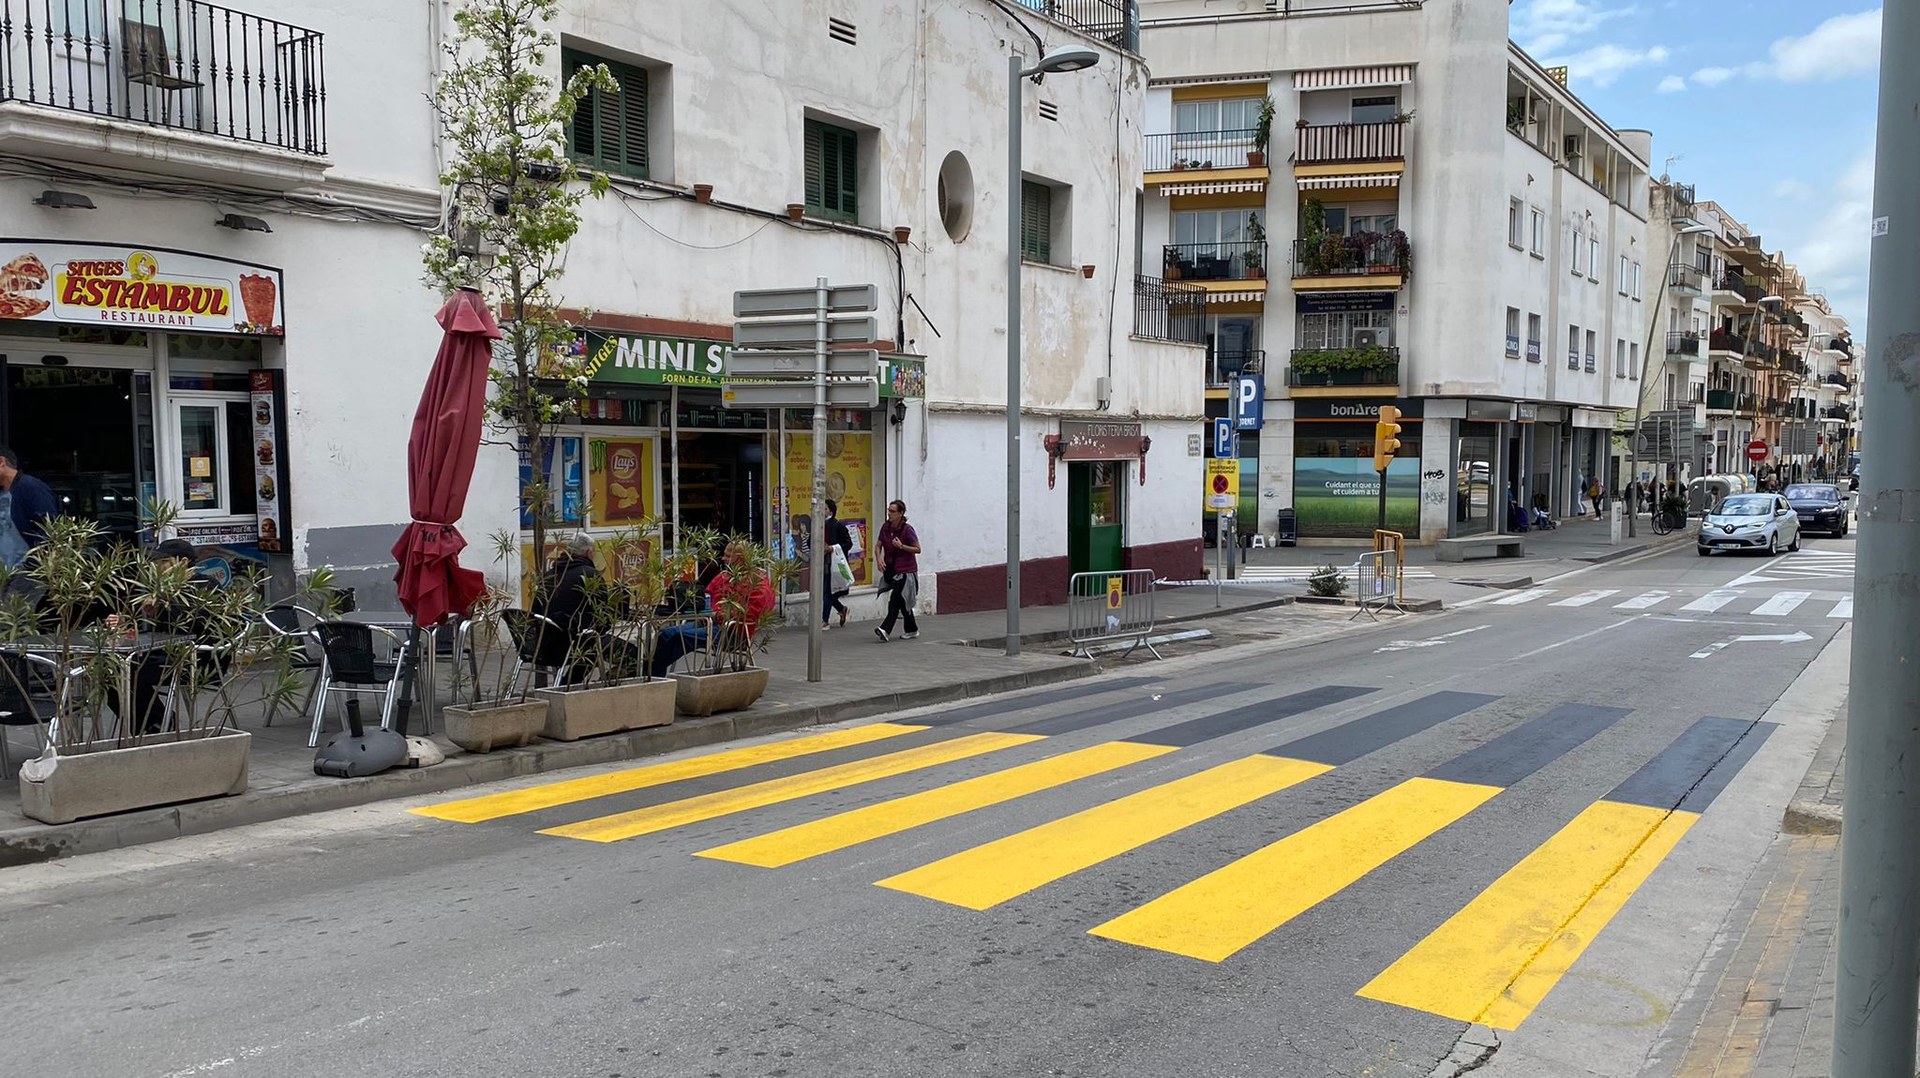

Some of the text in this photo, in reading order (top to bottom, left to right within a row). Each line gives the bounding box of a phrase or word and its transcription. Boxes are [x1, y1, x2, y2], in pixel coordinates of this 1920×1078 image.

[66, 260, 125, 277] SITGES
[62, 276, 228, 316] ESTAMBUL
[101, 310, 195, 325] RESTAURANT
[584, 335, 618, 379] SITGES
[615, 337, 696, 371] MINI
[662, 374, 686, 384] FORN
[688, 375, 699, 384] DE
[701, 376, 712, 385] PA
[1240, 379, 1256, 415] P
[1331, 404, 1379, 416] bonAre
[1219, 423, 1229, 453] P
[1325, 481, 1351, 489] Cuidant
[1352, 481, 1359, 489] el
[1359, 482, 1371, 490] que
